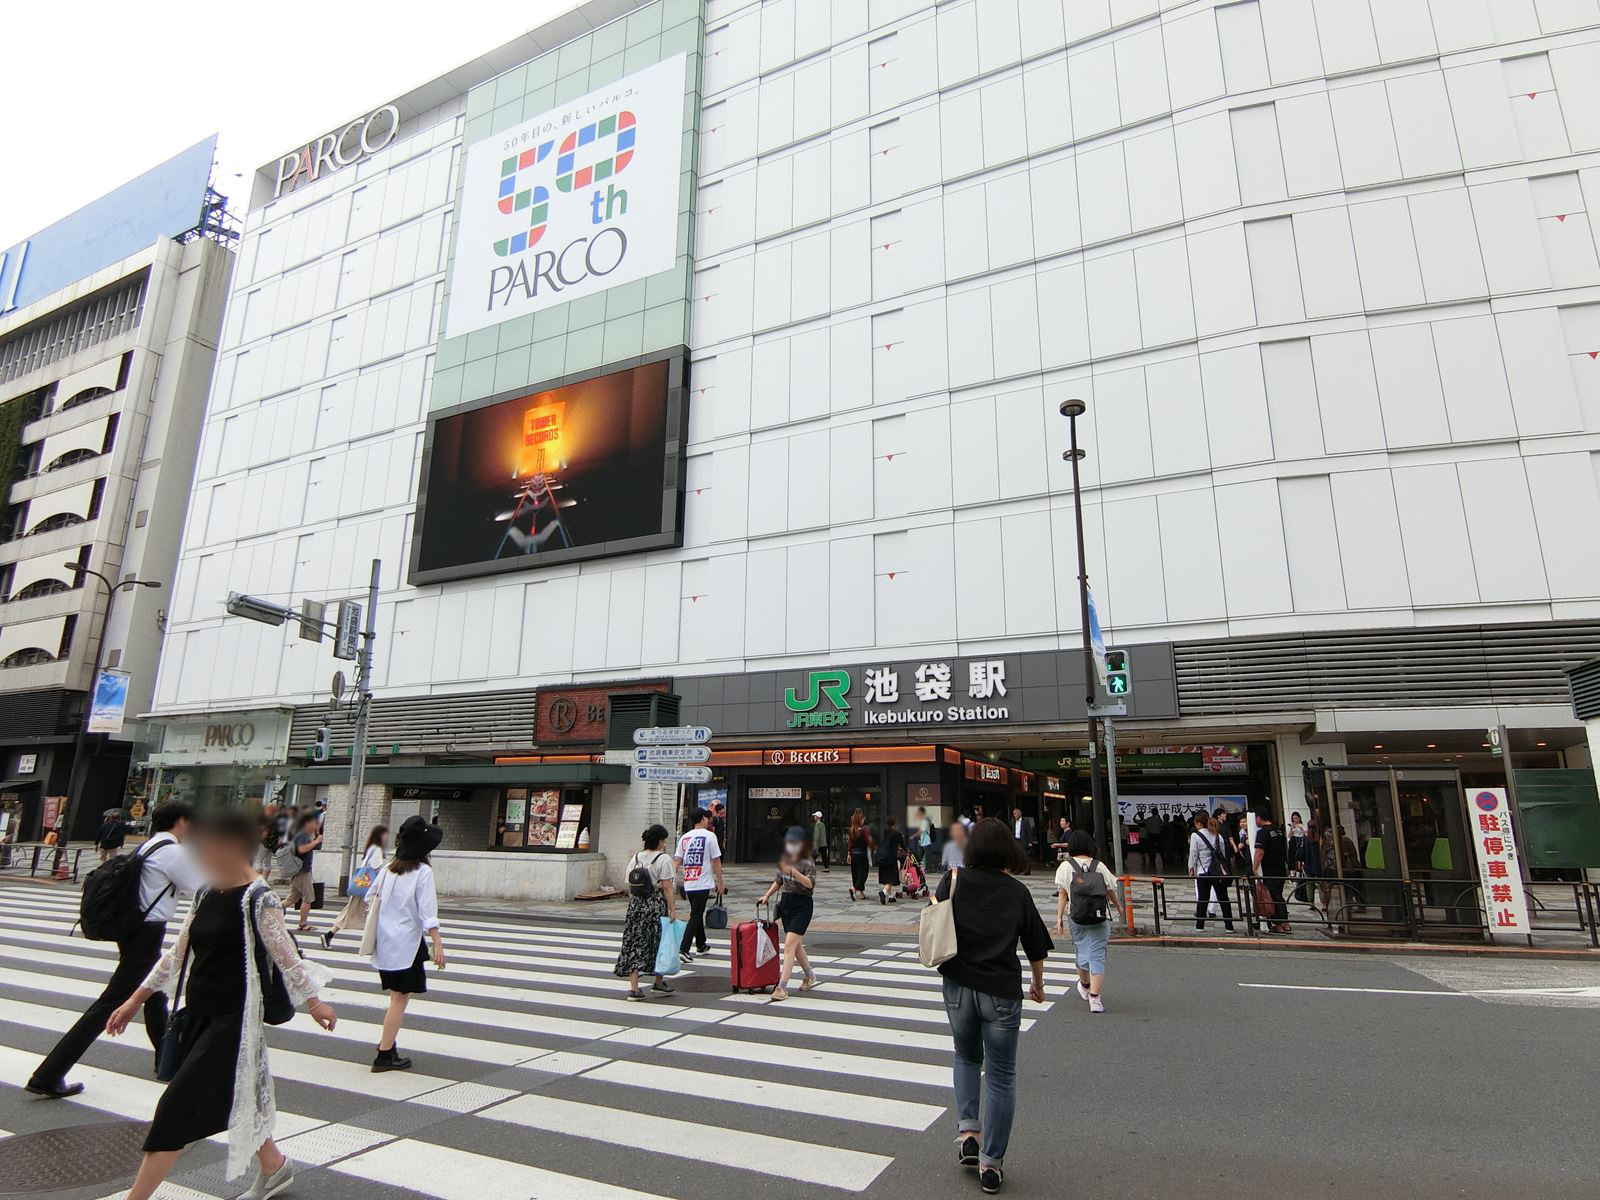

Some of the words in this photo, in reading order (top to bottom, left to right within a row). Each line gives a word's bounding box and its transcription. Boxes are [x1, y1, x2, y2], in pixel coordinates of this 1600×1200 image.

[274, 104, 400, 199] PARCO
[487, 227, 628, 312] PARCO
[784, 669, 852, 712] JR
[864, 659, 1008, 704] 池袋駅
[786, 711, 849, 728] JR東日本
[863, 706, 944, 725] Ikebukuro
[947, 704, 1009, 721] Station
[204, 723, 256, 747] PARCO
[790, 748, 839, 763] BECKER'S
[404, 788, 419, 797] ISP
[1135, 802, 1207, 816] 帝京平成大学
[1478, 813, 1518, 927] 駐停車禁止
